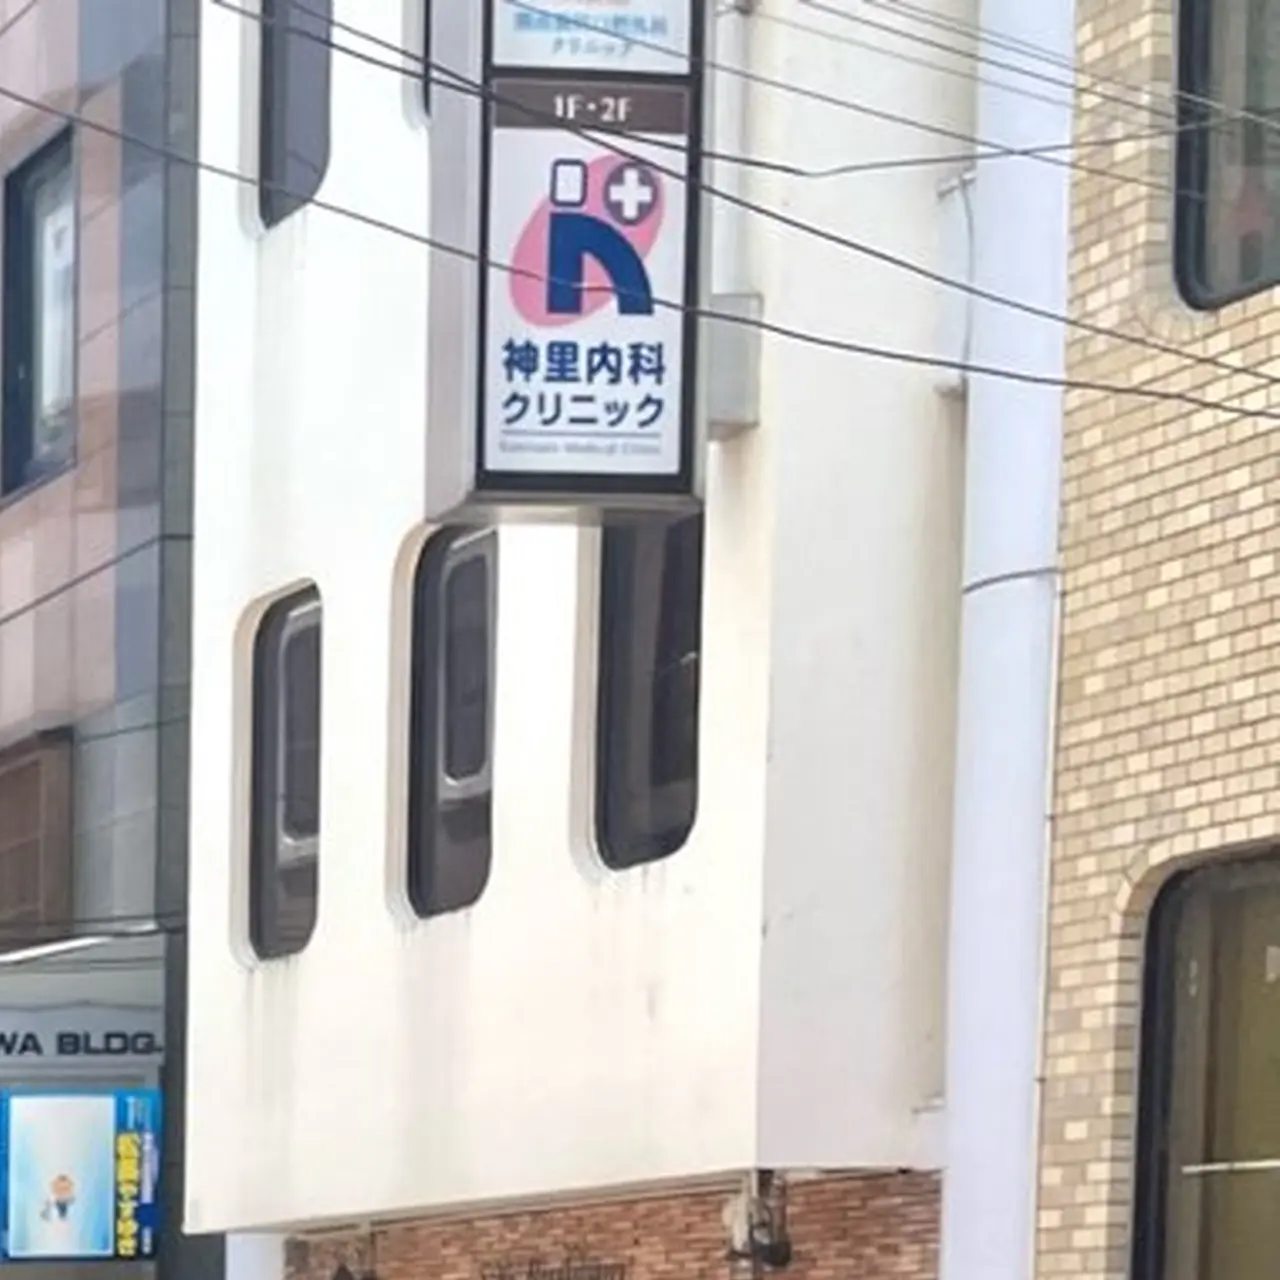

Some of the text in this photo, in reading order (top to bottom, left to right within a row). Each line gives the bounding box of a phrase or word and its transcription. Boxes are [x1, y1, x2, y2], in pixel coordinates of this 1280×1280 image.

[502, 338, 665, 386] 神里内科
[502, 392, 665, 428] クリニック
